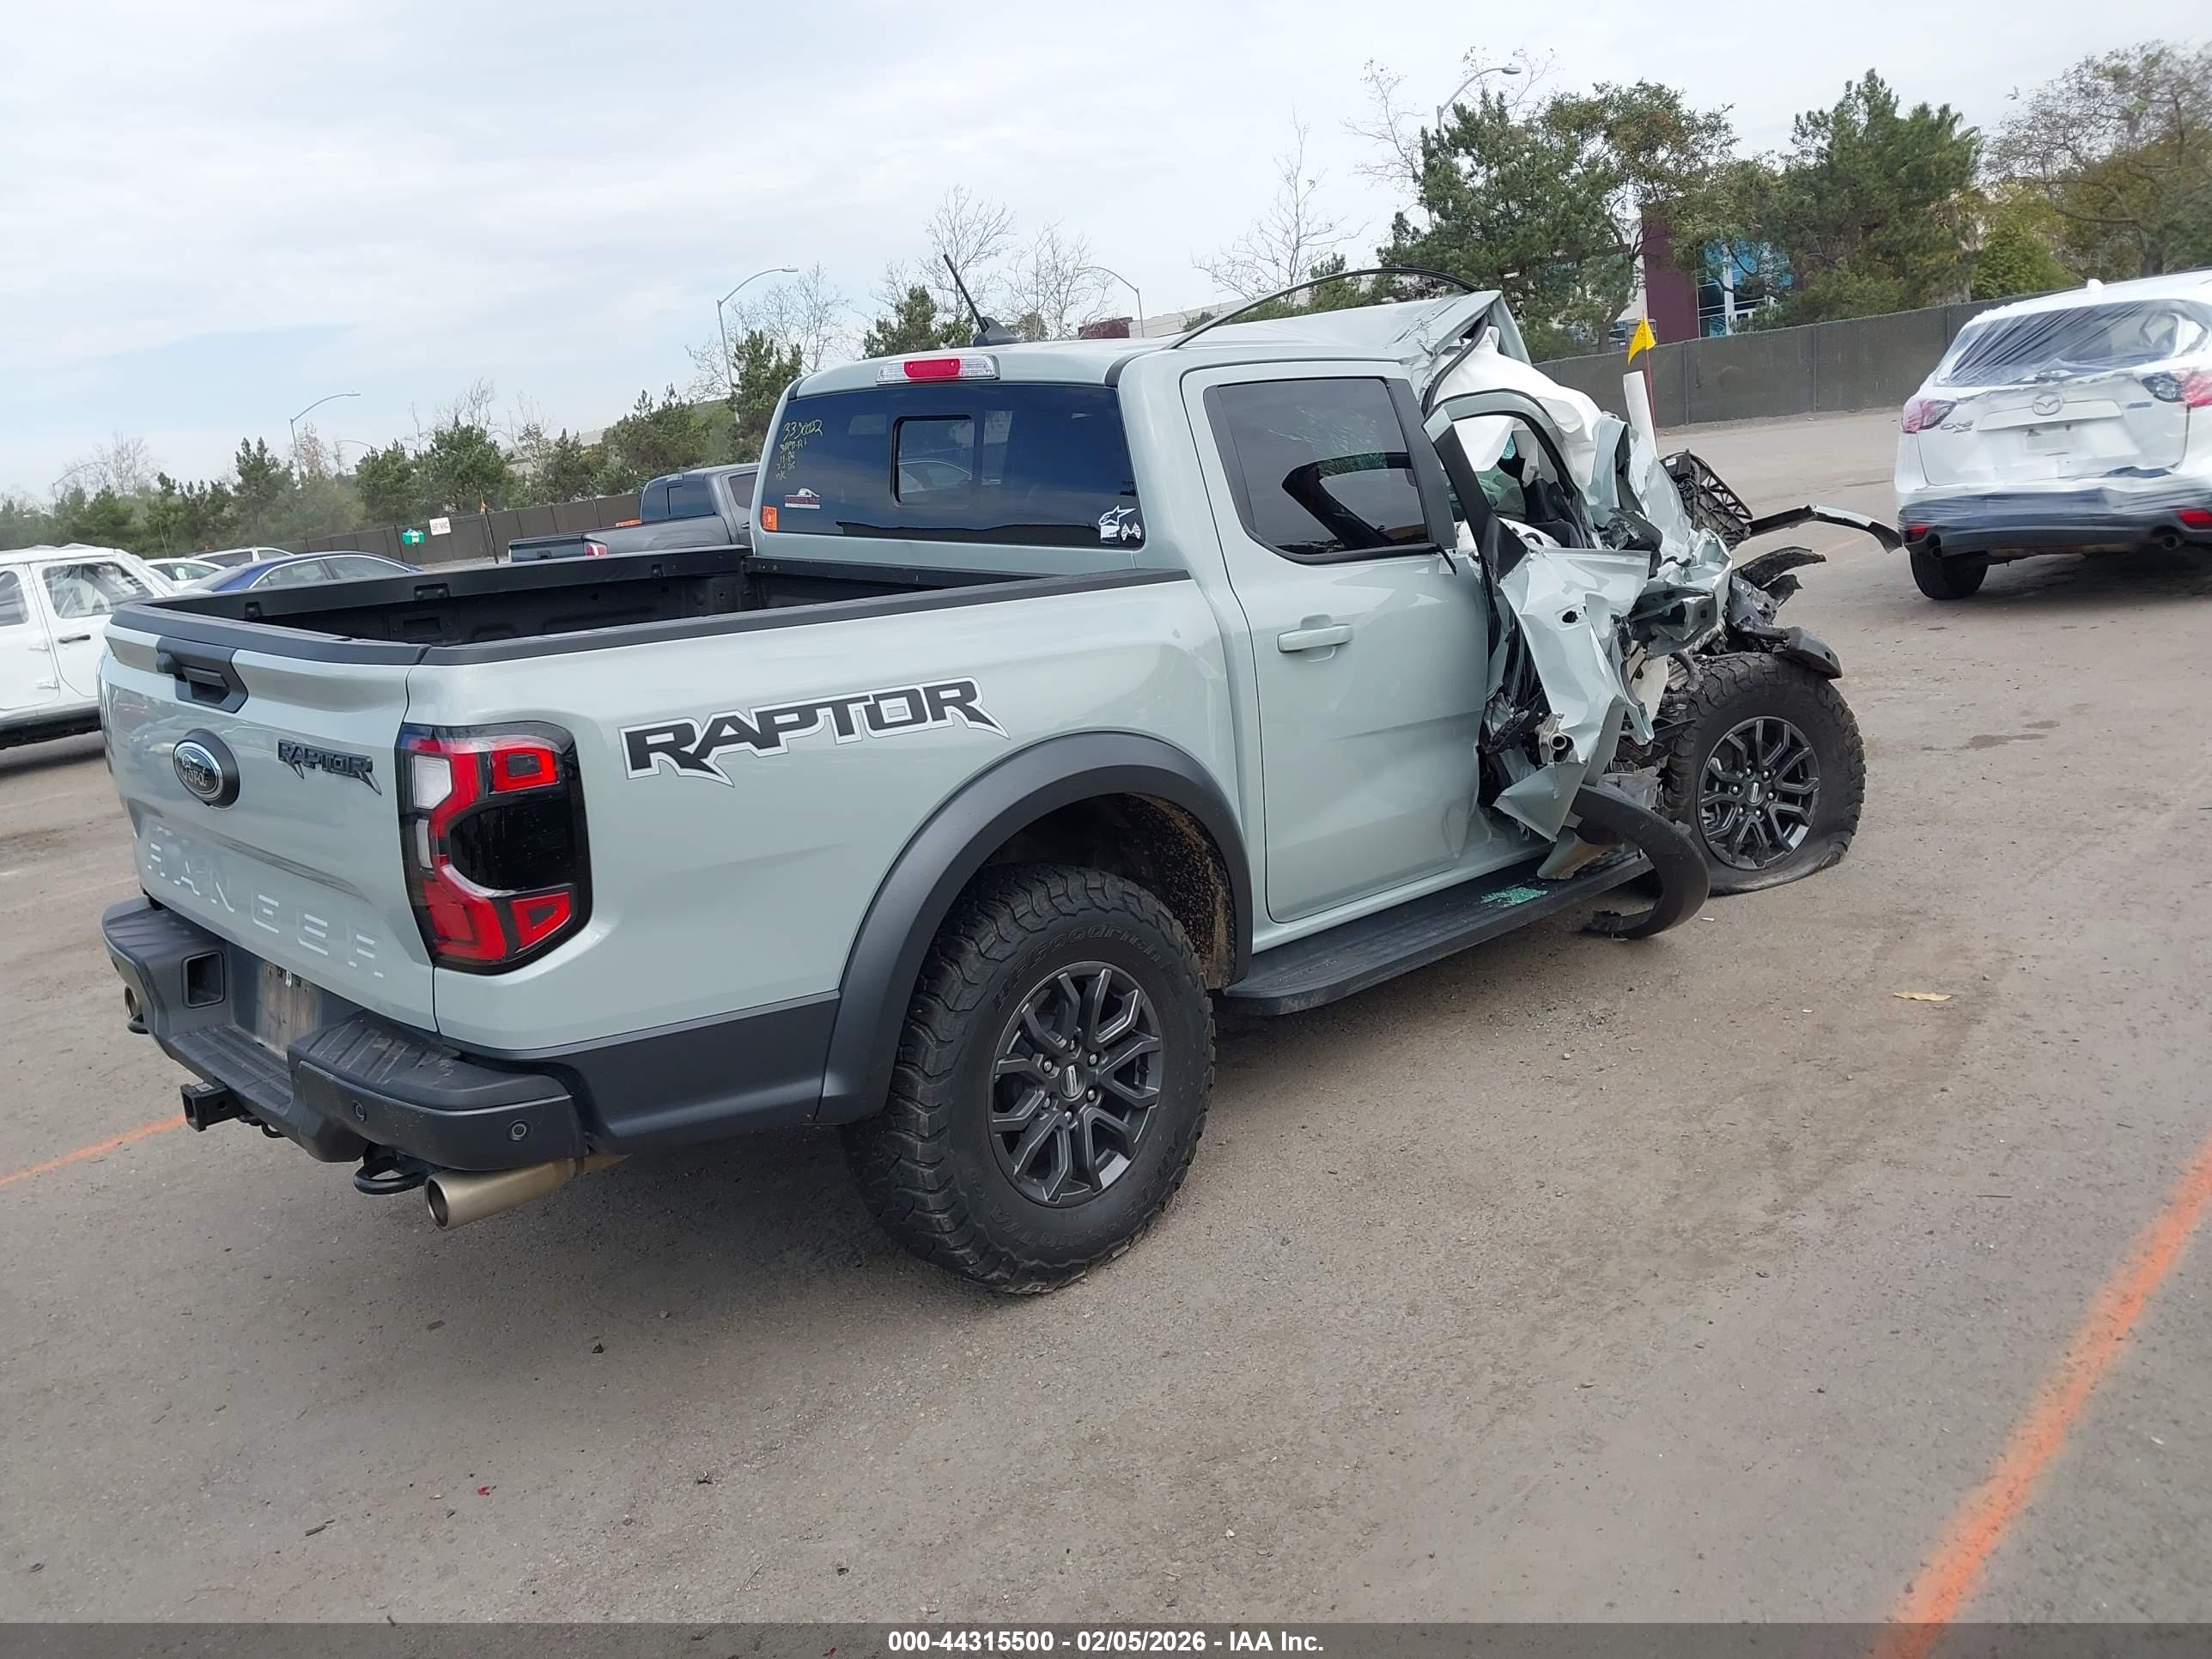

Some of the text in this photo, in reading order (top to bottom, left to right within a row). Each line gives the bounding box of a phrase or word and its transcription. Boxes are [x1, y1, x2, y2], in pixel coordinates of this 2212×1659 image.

[178, 753, 207, 787] Ford
[277, 738, 382, 796] RAPTOR
[618, 675, 1012, 788] RAPTOR
[146, 841, 386, 979] RANGER
